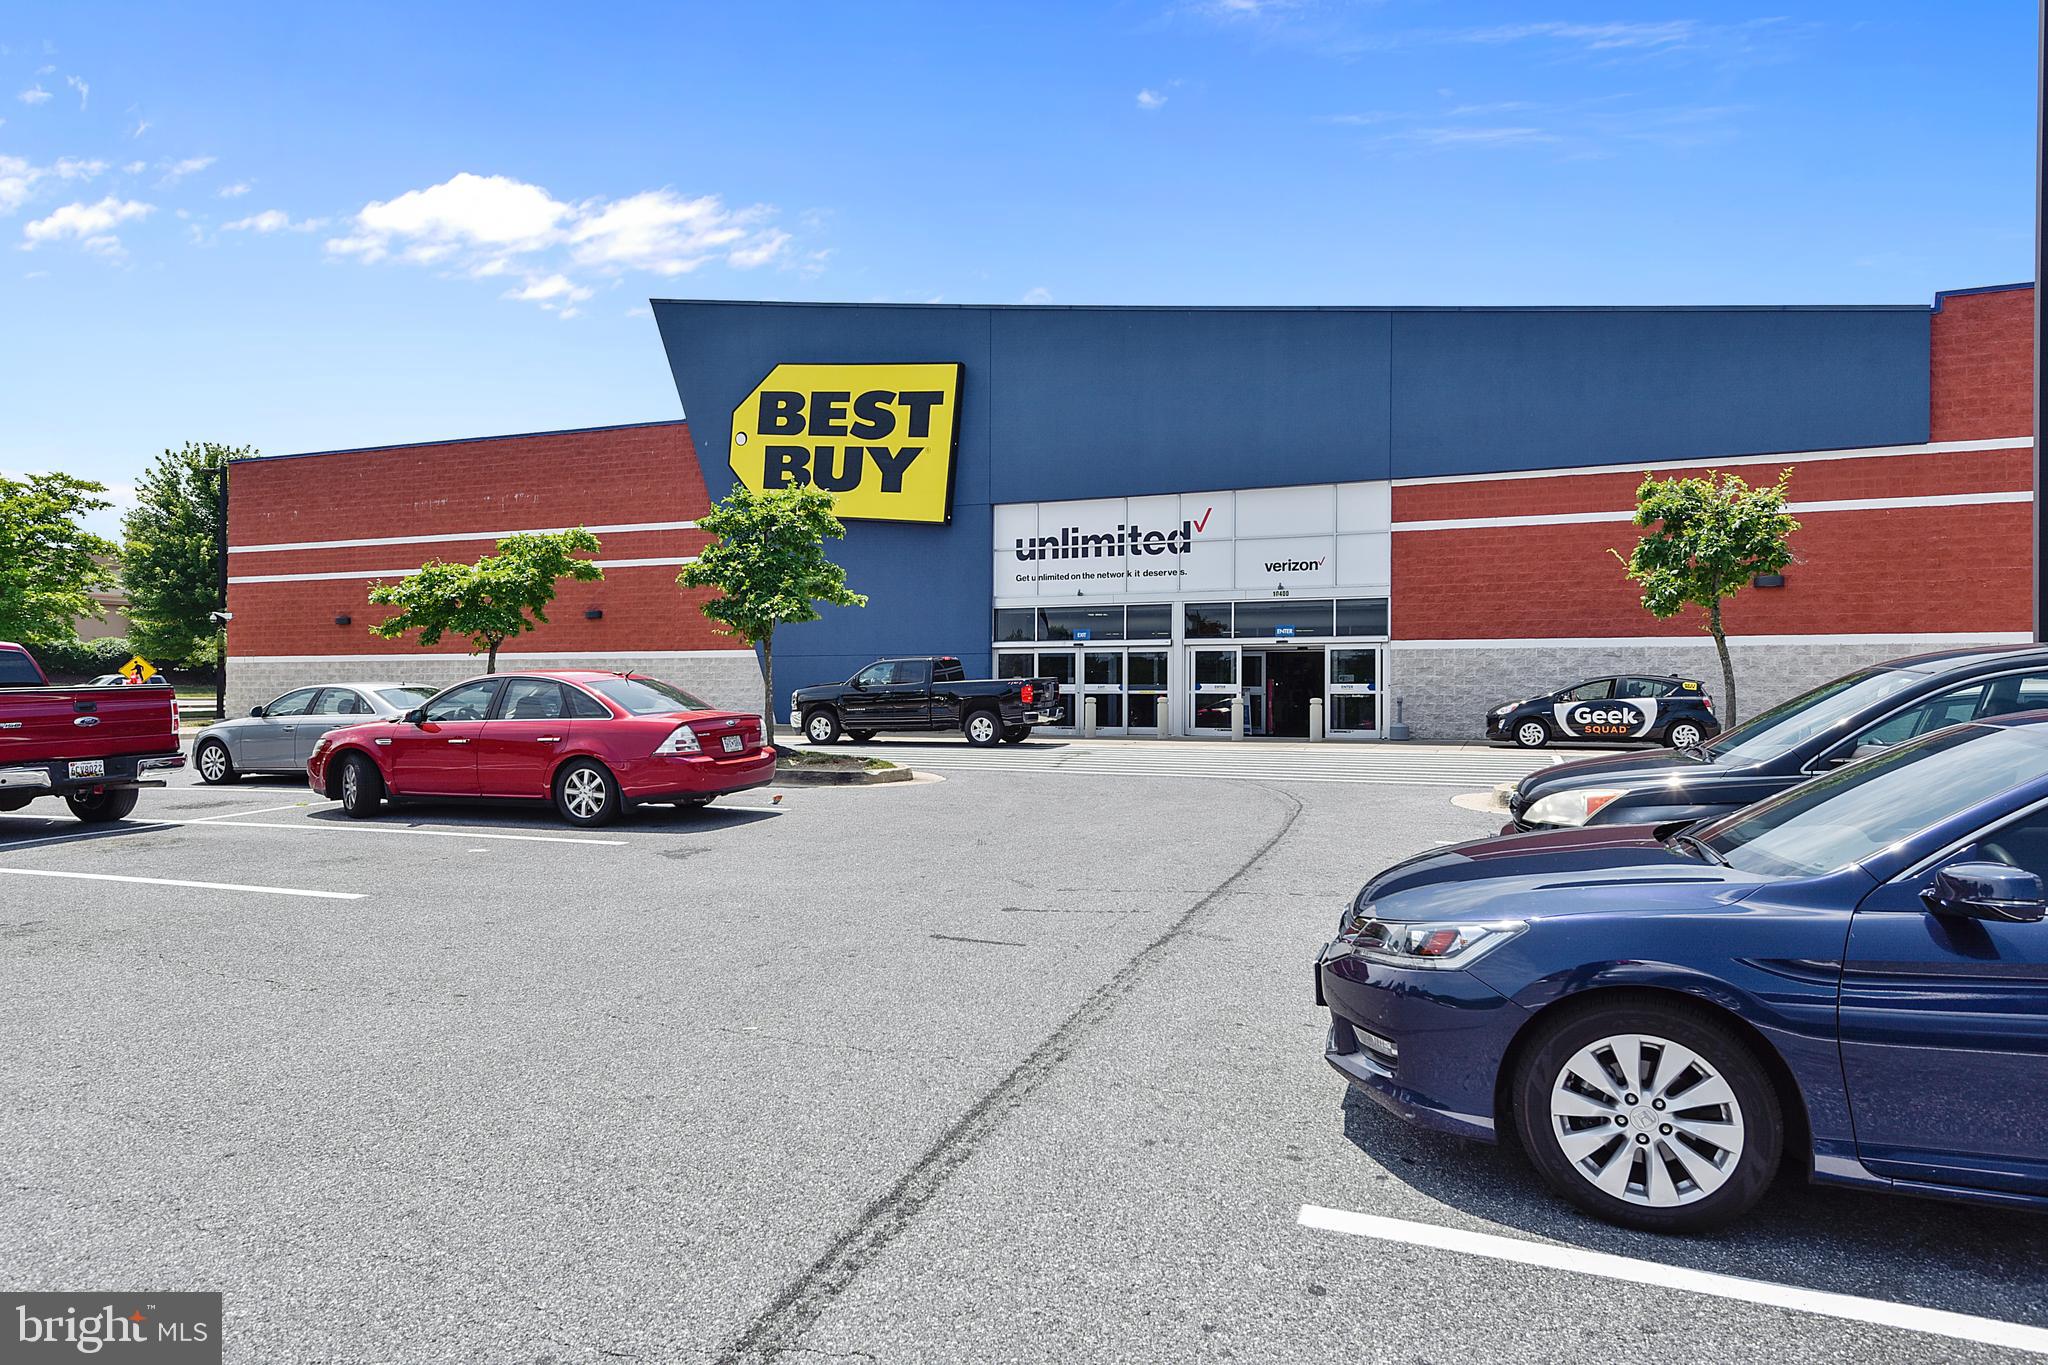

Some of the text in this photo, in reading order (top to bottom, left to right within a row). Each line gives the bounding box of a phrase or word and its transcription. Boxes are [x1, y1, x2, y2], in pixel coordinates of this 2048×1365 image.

[757, 390, 945, 440] BEST
[763, 445, 924, 493] BUY
[1015, 520, 1191, 561] unlimited
[1264, 558, 1319, 572] verizon
[1015, 574, 1030, 582] Get
[1031, 572, 1070, 581] unlimited
[1081, 571, 1095, 579] the
[1096, 569, 1132, 579] network
[1134, 569, 1141, 577] it
[1574, 707, 1638, 724] Geek
[1584, 725, 1627, 734] SQUAD
